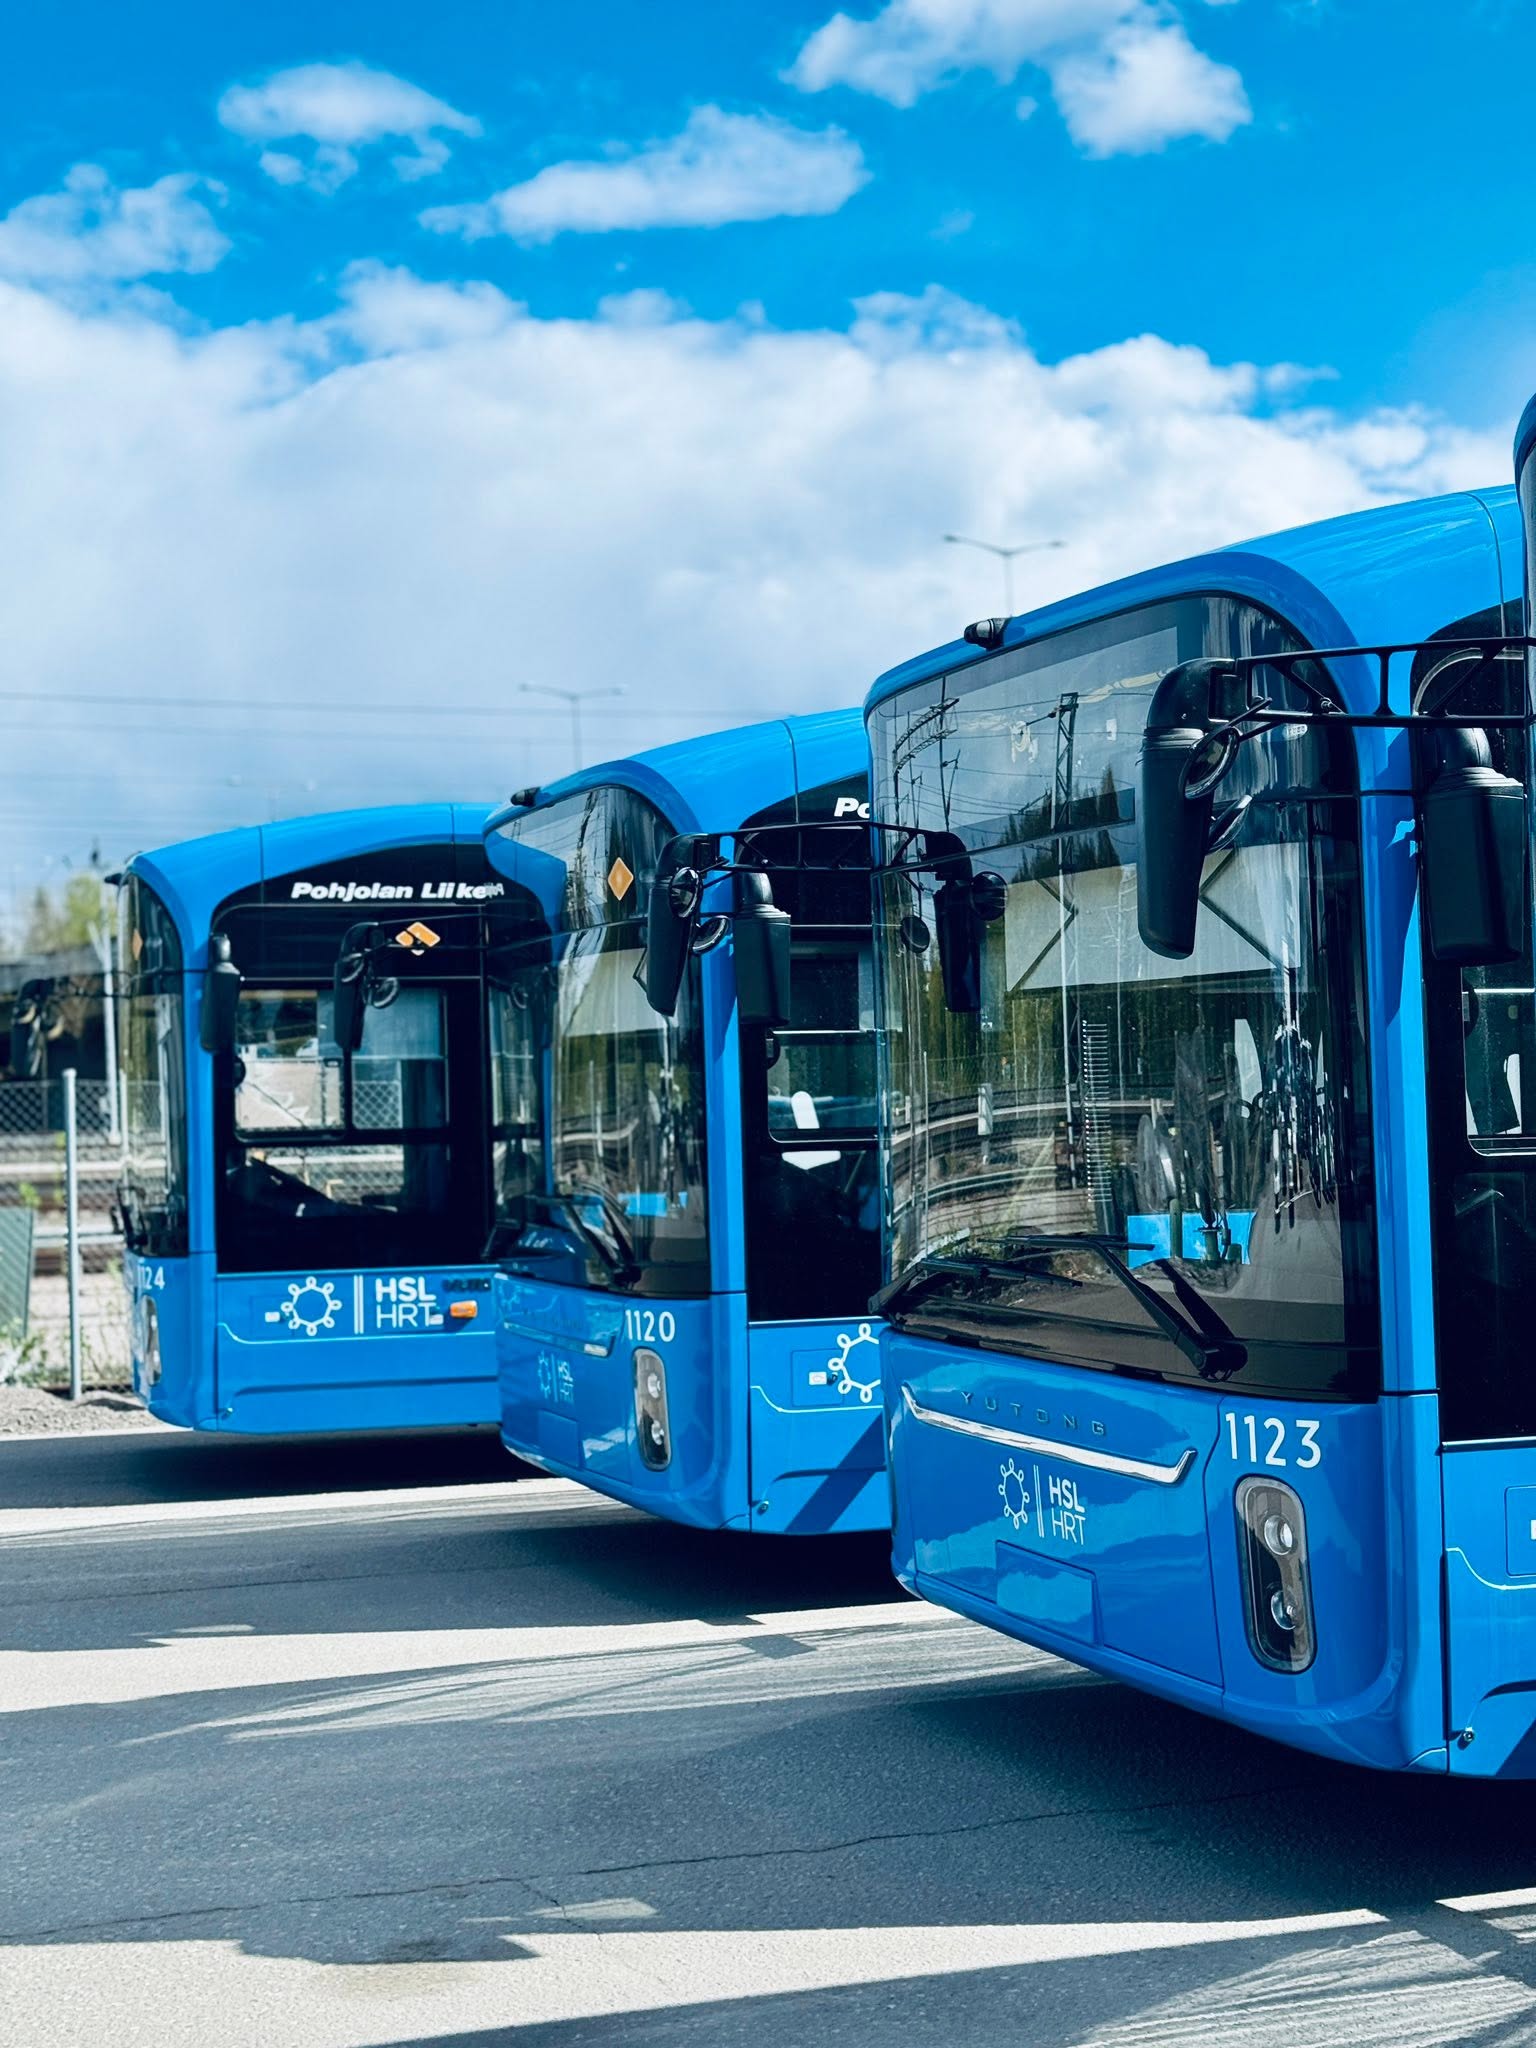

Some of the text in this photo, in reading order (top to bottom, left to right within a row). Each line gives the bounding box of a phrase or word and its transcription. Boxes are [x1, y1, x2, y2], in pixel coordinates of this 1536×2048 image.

[291, 882, 414, 902] Pohjolan
[375, 1276, 437, 1302] HSL
[376, 1302, 437, 1328] HRT
[625, 1309, 675, 1342] 1120
[960, 1391, 1106, 1436] YUTONG
[1225, 1412, 1321, 1469] 1123
[1048, 1474, 1086, 1513] HSL
[1051, 1507, 1086, 1546] HRT
